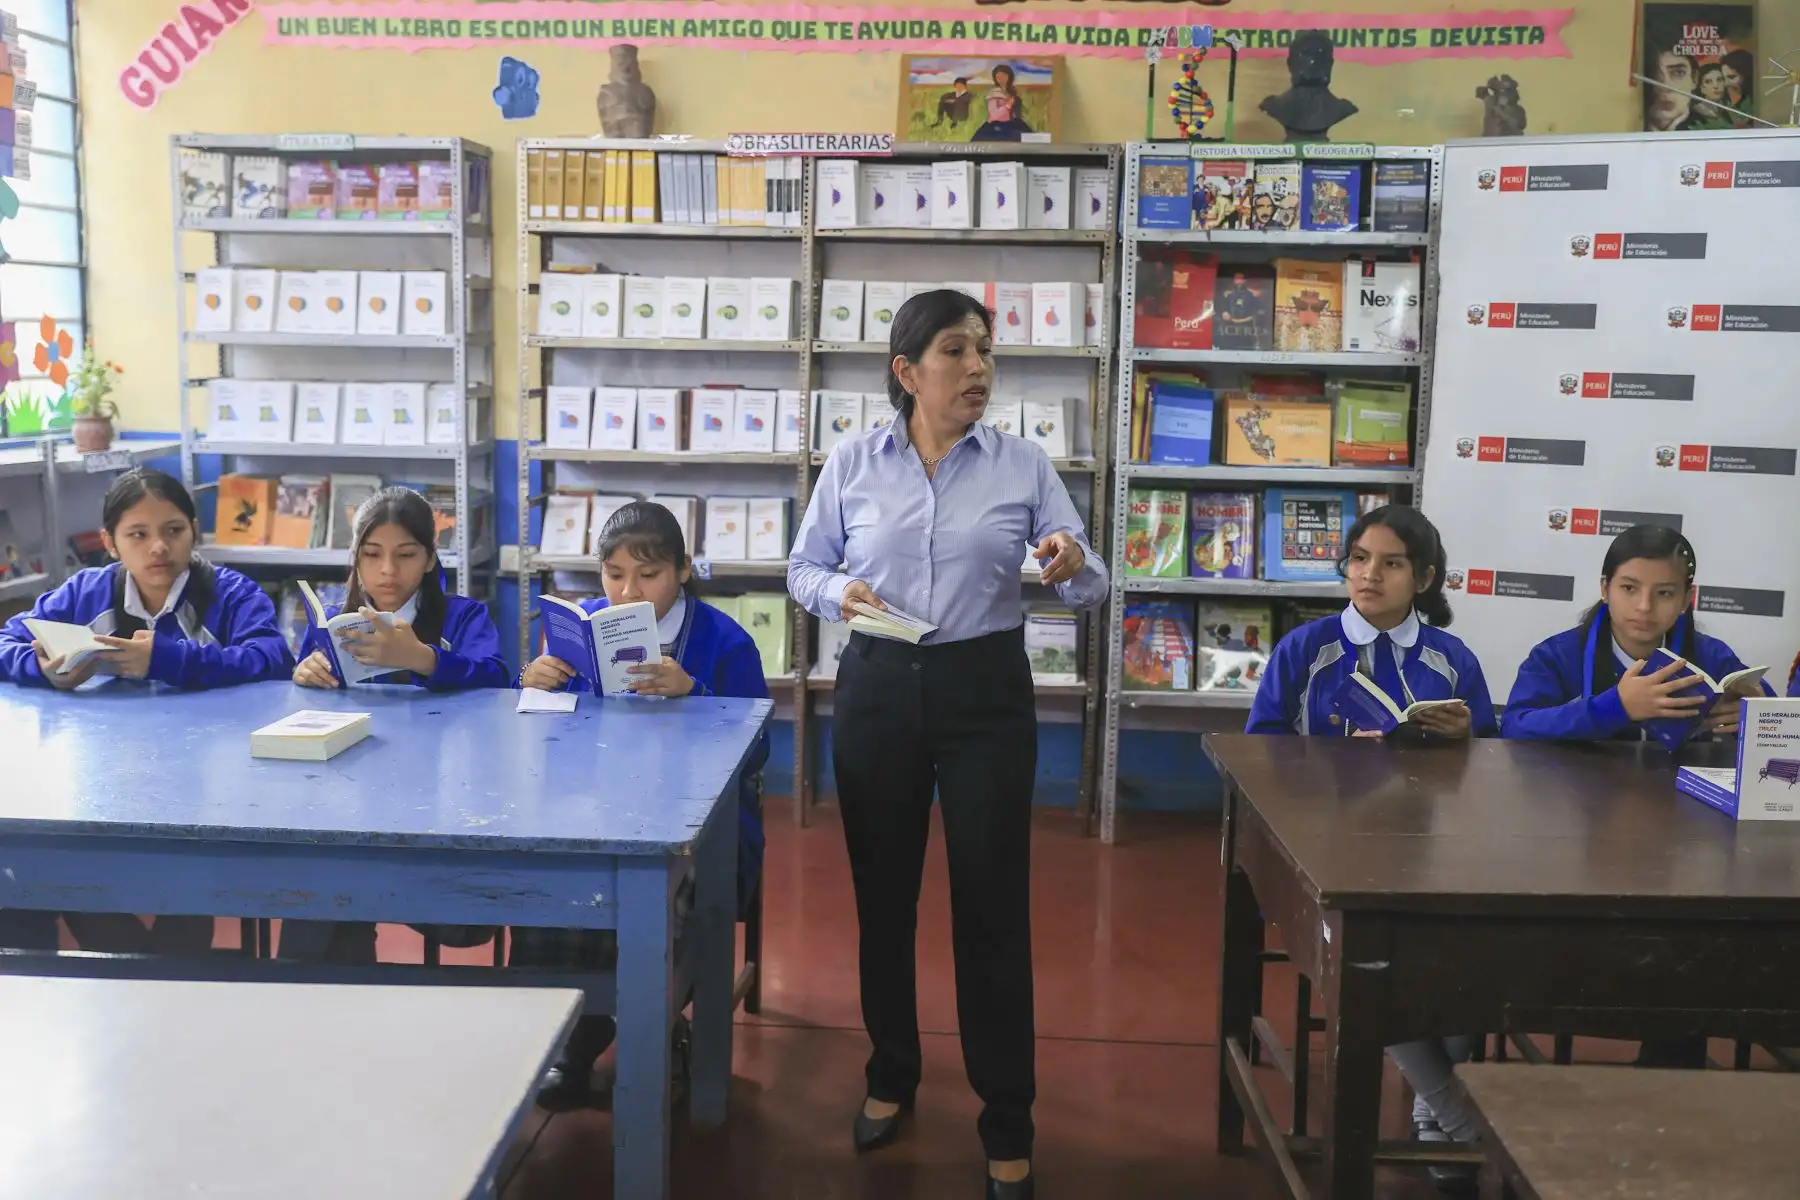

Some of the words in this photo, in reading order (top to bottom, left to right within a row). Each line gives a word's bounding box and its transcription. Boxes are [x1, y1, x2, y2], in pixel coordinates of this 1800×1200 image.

[277, 17, 310, 36] UN
[317, 17, 377, 36] BUEN
[385, 18, 461, 38] LIBRO
[612, 19, 676, 37] BUEN
[682, 19, 765, 38] AMIGO
[771, 20, 818, 41] QUE
[950, 21, 967, 39] A
[1065, 25, 1130, 46] VIDA
[1316, 28, 1417, 48] UNTOS
[1682, 25, 1720, 39] LOVE
[1672, 44, 1729, 56] CHOLERA
[1193, 147, 1238, 157] HISTORIA
[1241, 146, 1295, 156] UNIVERSAL
[1360, 289, 1418, 308] Nexs
